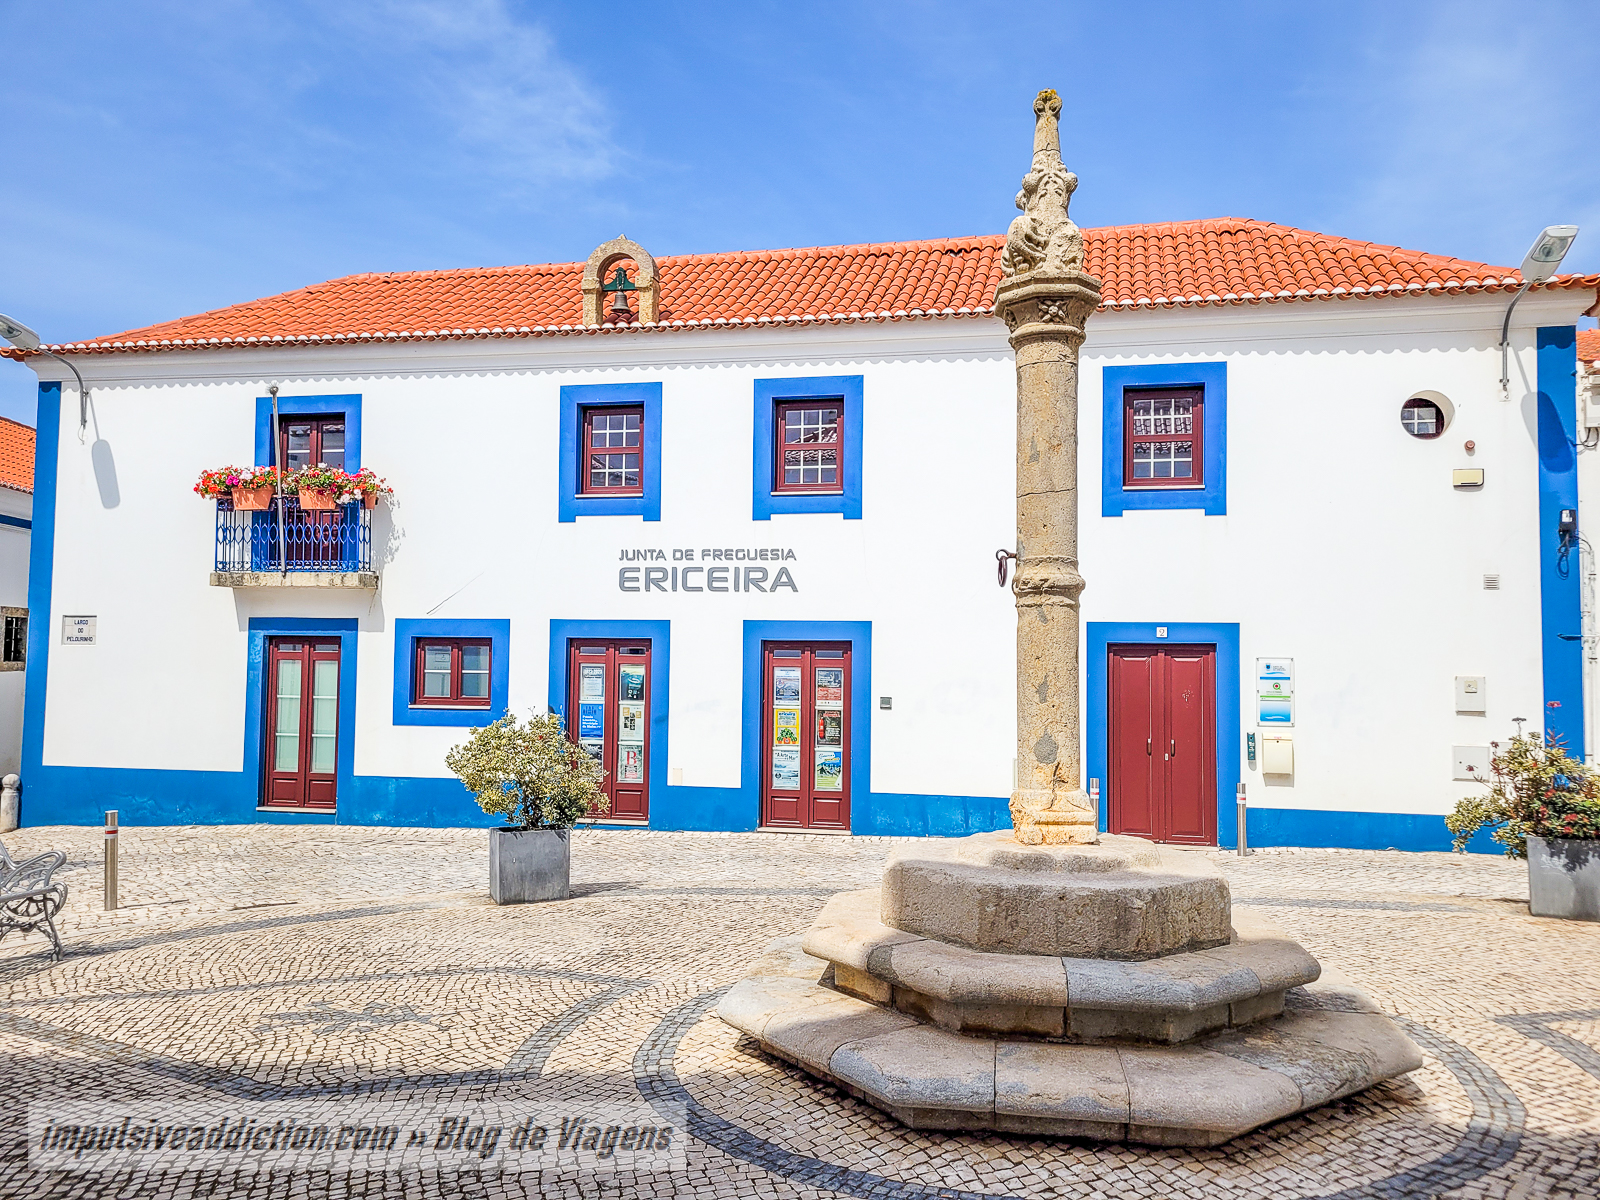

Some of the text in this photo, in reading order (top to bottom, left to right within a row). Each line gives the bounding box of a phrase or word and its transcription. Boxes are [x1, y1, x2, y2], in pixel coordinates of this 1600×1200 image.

[618, 549, 797, 561] JUNTA DE FREGUESIA
[619, 567, 799, 592] ERICEIRA
[1158, 628, 1165, 637] 2
[626, 750, 638, 766] B
